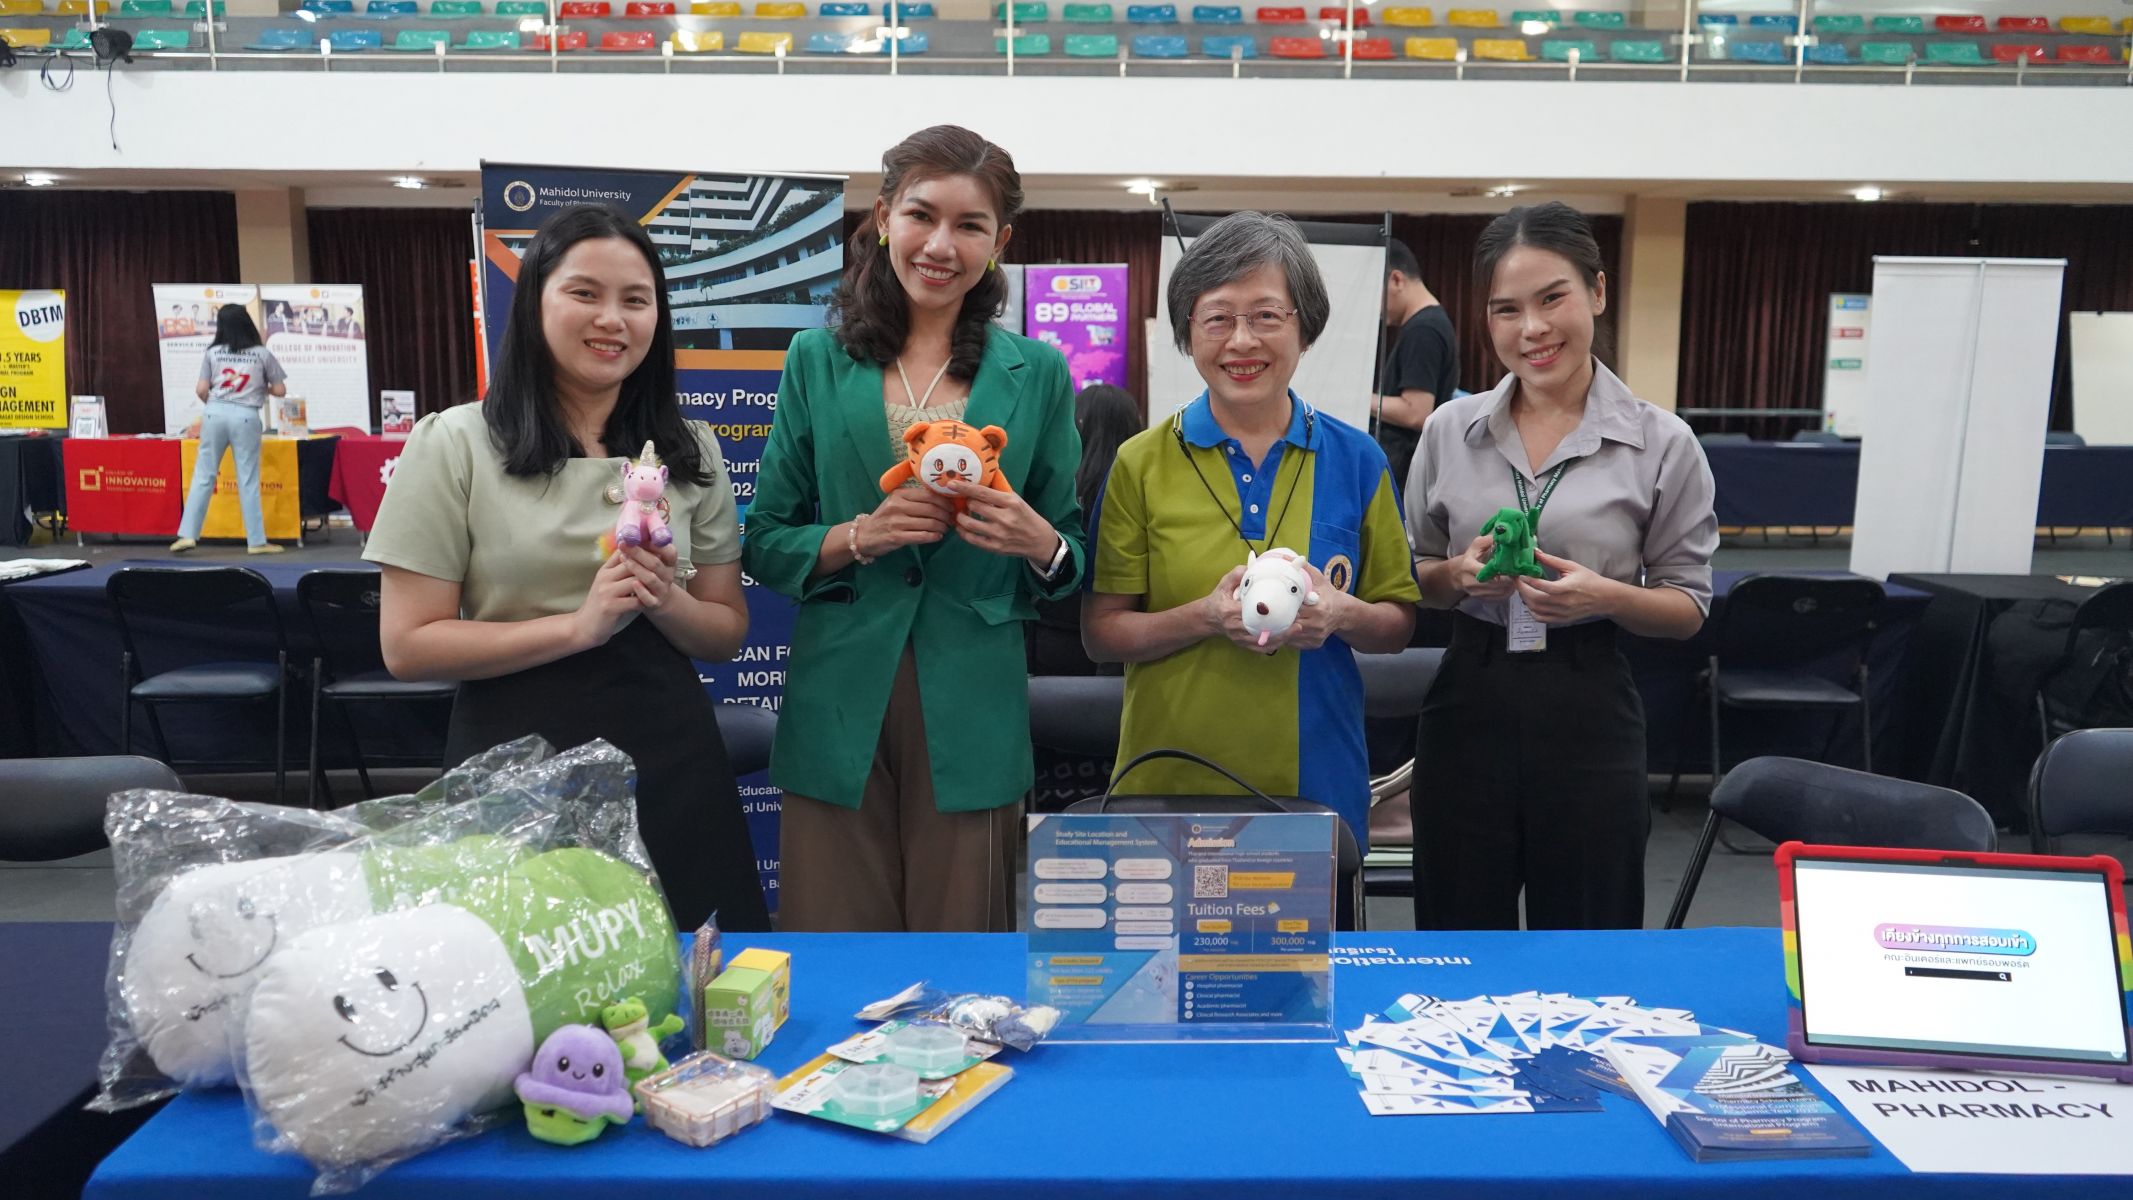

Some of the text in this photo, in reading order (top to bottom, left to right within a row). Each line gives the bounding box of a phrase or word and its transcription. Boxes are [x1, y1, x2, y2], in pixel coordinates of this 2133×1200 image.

[540, 187, 632, 202] Mahidol University
[540, 199, 564, 208] Faculty
[18, 305, 63, 328] DBTM
[1035, 302, 1069, 323] 89
[271, 344, 301, 353] COLLEGE
[314, 344, 357, 353] INNOVATION
[14, 352, 42, 363] YEARS
[217, 356, 257, 364] UNIVERSITY
[220, 368, 251, 392] 27
[732, 388, 778, 411] Prog
[105, 475, 167, 488] INNOVATION
[1541, 478, 1557, 498] Pharmacy
[1055, 831, 1073, 839] Study
[1093, 839, 1134, 847] Management
[1135, 839, 1158, 847] System
[1187, 903, 1266, 916] Tuition Fees
[523, 898, 646, 974] MUPY
[1193, 937, 1229, 947] 230,000
[1271, 937, 1305, 947] 300,000
[1208, 973, 1258, 981] Opportunities
[573, 958, 646, 1017] Relax
[1846, 1078, 2044, 1093] MAHIDOL
[1871, 1102, 2117, 1119] PHARMACY
[1740, 1116, 1786, 1124] Pharmacy
